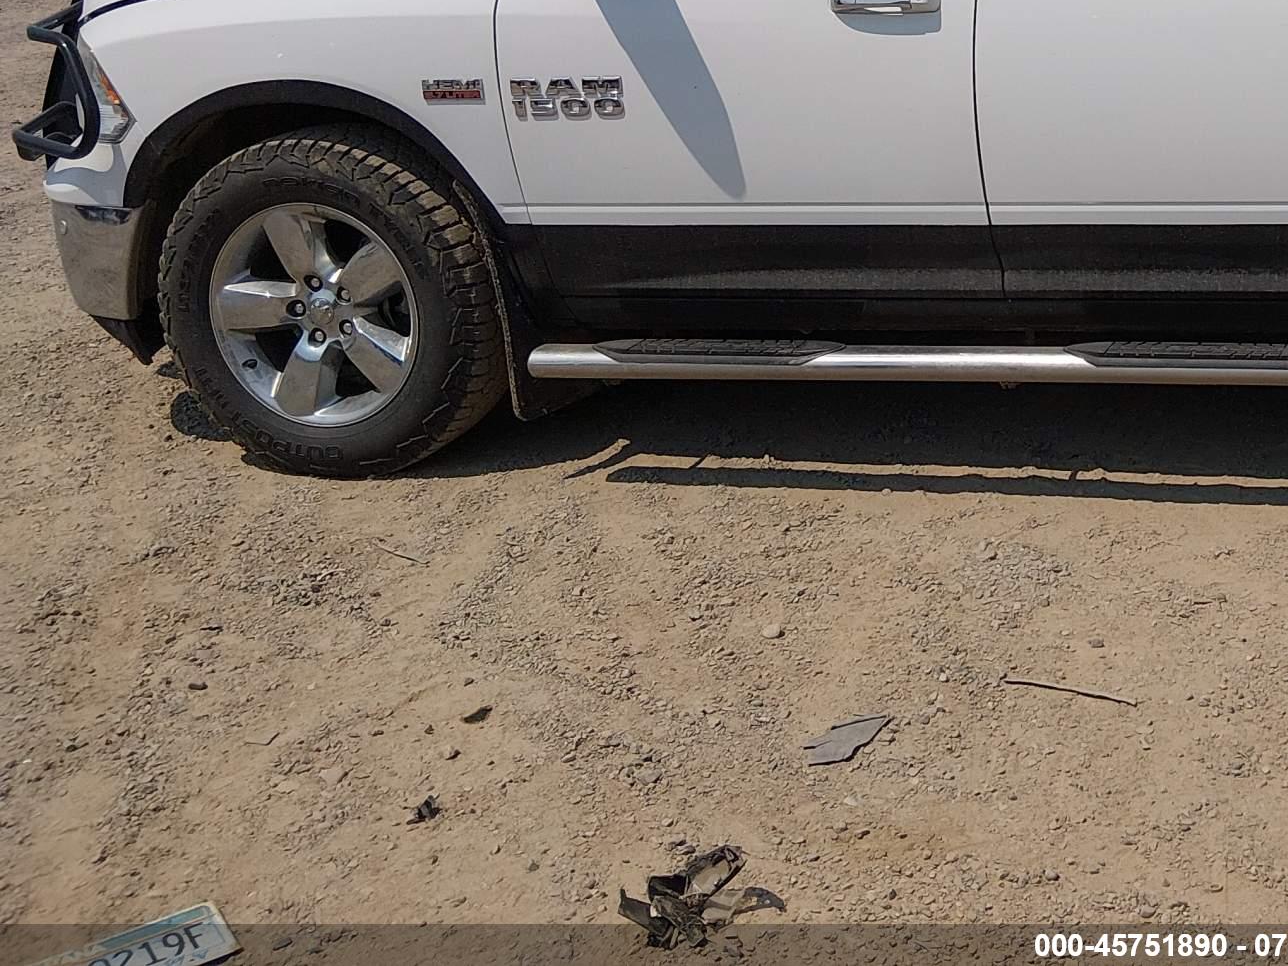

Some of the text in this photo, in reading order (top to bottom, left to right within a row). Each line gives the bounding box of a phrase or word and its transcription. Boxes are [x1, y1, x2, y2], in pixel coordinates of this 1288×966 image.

[421, 78, 483, 90] HEMI
[510, 75, 624, 99] RAM
[512, 97, 625, 120] 1500
